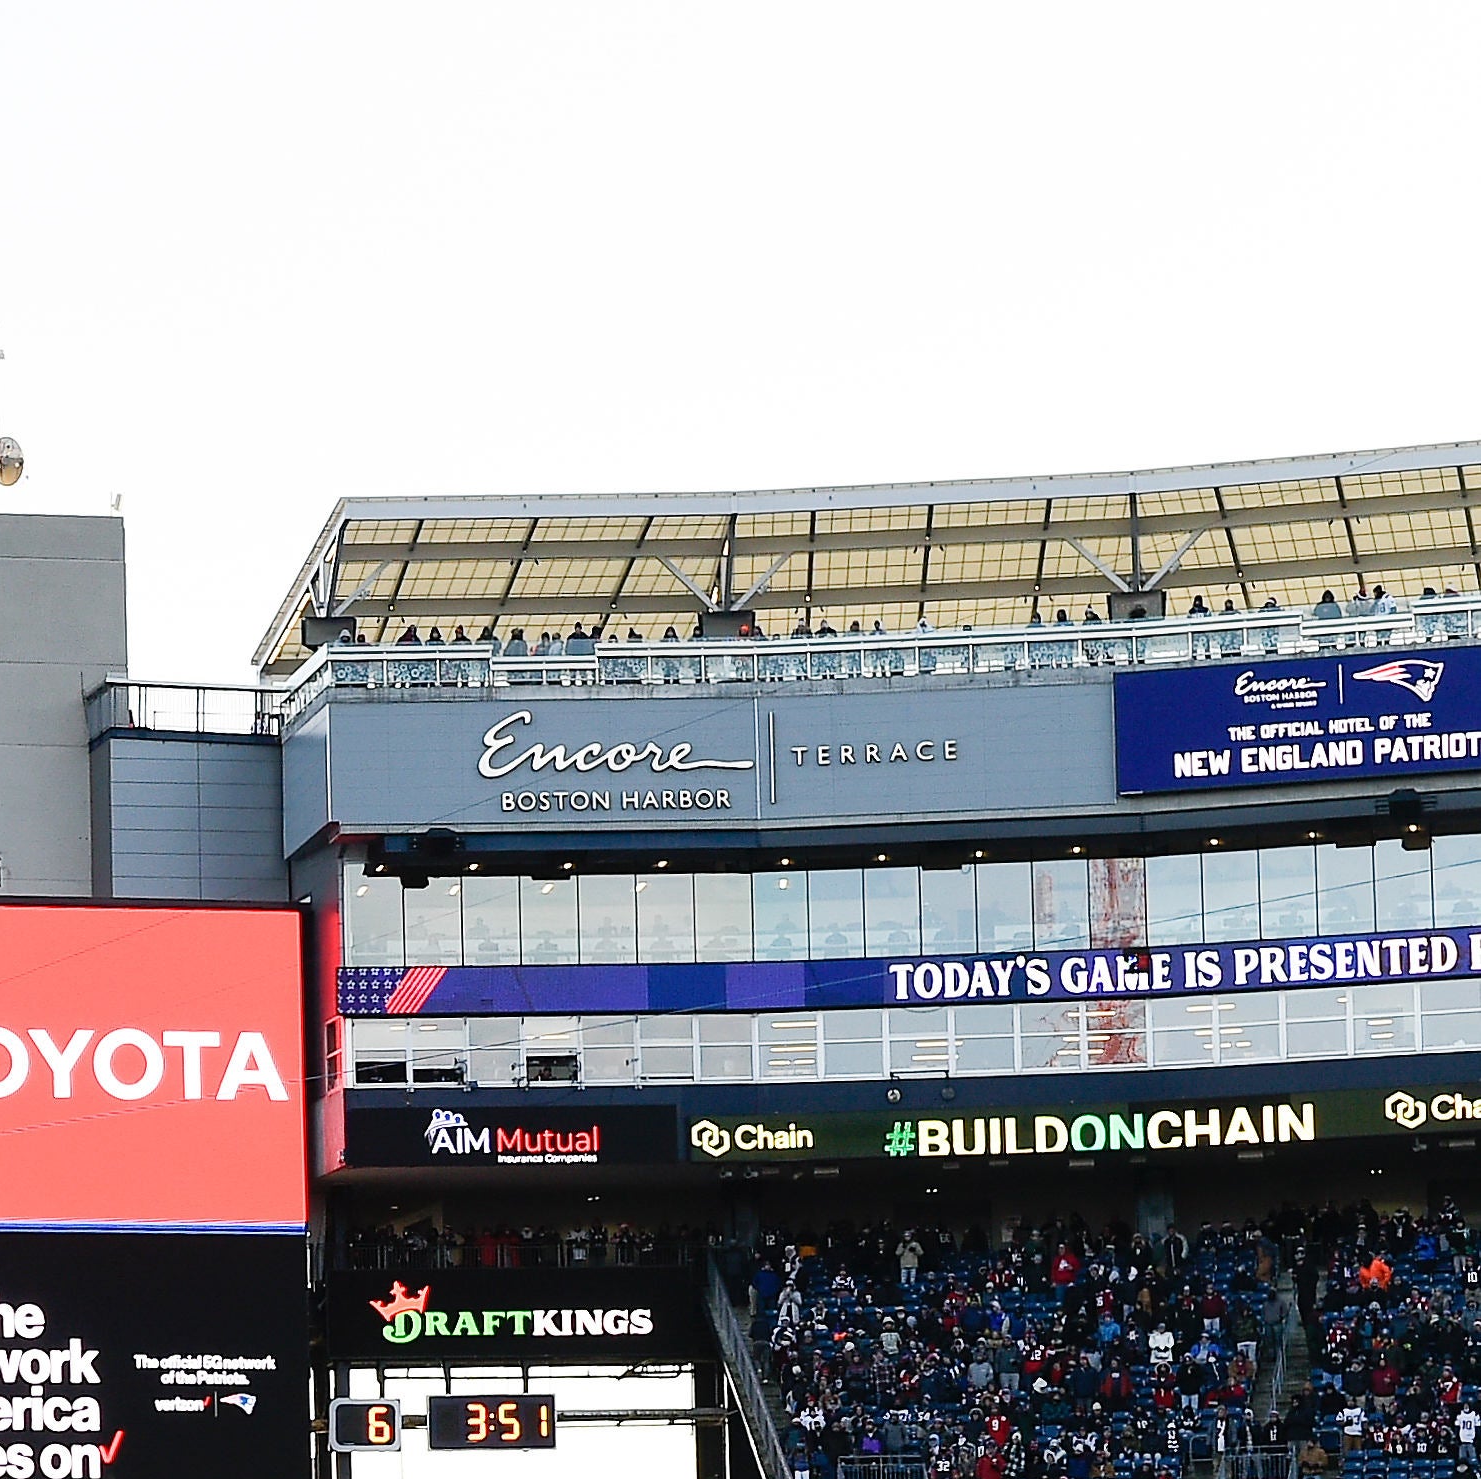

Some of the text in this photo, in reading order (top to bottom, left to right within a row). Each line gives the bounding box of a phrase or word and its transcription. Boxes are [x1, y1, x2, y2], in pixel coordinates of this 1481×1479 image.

[1234, 671, 1327, 696] Encore
[1228, 712, 1432, 741] THE OFFICIAL HOTEL OF THE
[477, 710, 755, 779] Encore
[791, 740, 959, 767] TERRACE
[1174, 750, 1231, 778] NEW
[1241, 740, 1364, 773] ENGLAND
[500, 789, 732, 811] BOSTON HARBOR
[889, 955, 1053, 1001] TODAY'S
[1060, 953, 1173, 995] GAME
[1184, 950, 1225, 988] IS
[1233, 933, 1459, 986] PRESENTED
[431, 1126, 492, 1155] AIM
[496, 1124, 600, 1154] Mutual
[734, 1121, 814, 1151] Chain
[884, 1103, 1316, 1158] #BUILDONCHAIN
[497, 1152, 598, 1164] Insurance Companies
[382, 1308, 654, 1344] DRAFTKINGS
[133, 1354, 277, 1370] The official 5G network
[160, 1370, 176, 1385] of
[176, 1371, 197, 1385] the
[154, 1396, 205, 1412] verizon
[368, 1406, 390, 1444] 6
[467, 1402, 548, 1442] 3:51
[40, 1441, 101, 1479] on
